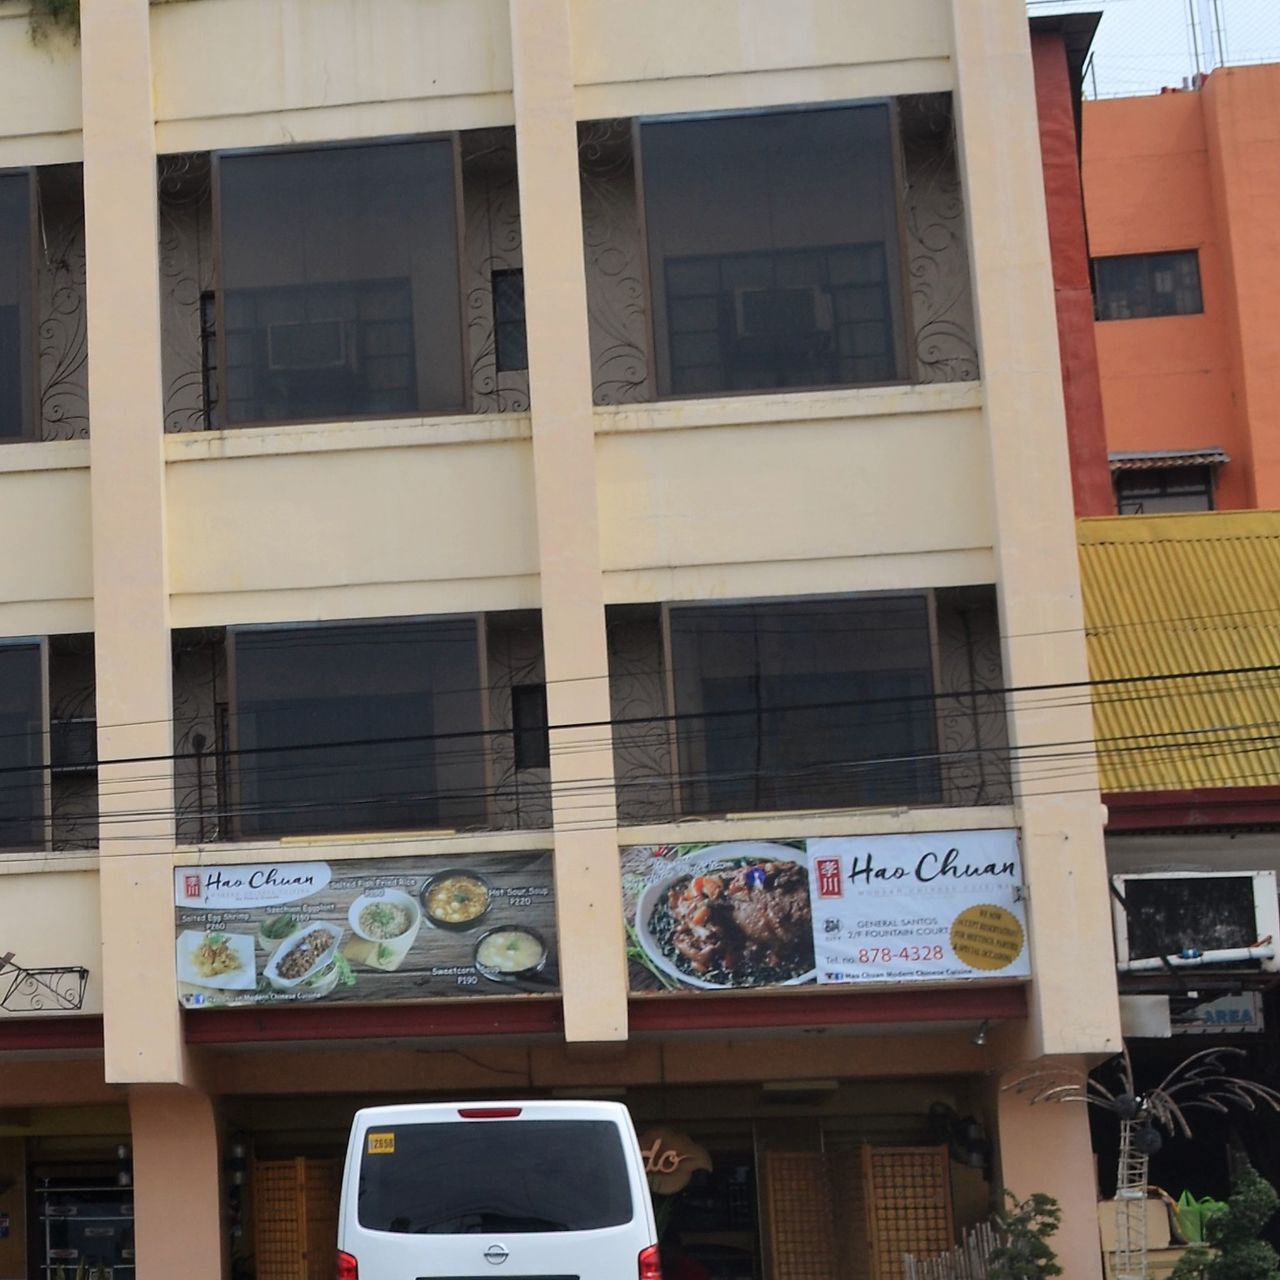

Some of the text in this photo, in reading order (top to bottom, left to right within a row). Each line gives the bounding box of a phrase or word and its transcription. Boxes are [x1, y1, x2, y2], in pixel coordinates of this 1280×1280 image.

[848, 848, 1015, 885] Hao Chuan
[204, 867, 314, 891] Hao Chuan
[488, 888, 505, 896] Hot
[223, 911, 250, 921] Shrimp
[856, 917, 939, 929] GENERAL SANTOS
[864, 929, 914, 938] FOUNTAIN
[916, 926, 949, 936] COURT
[858, 944, 945, 965] 878-4328
[915, 969, 945, 978] Chinese
[1203, 1008, 1254, 1025] AREA
